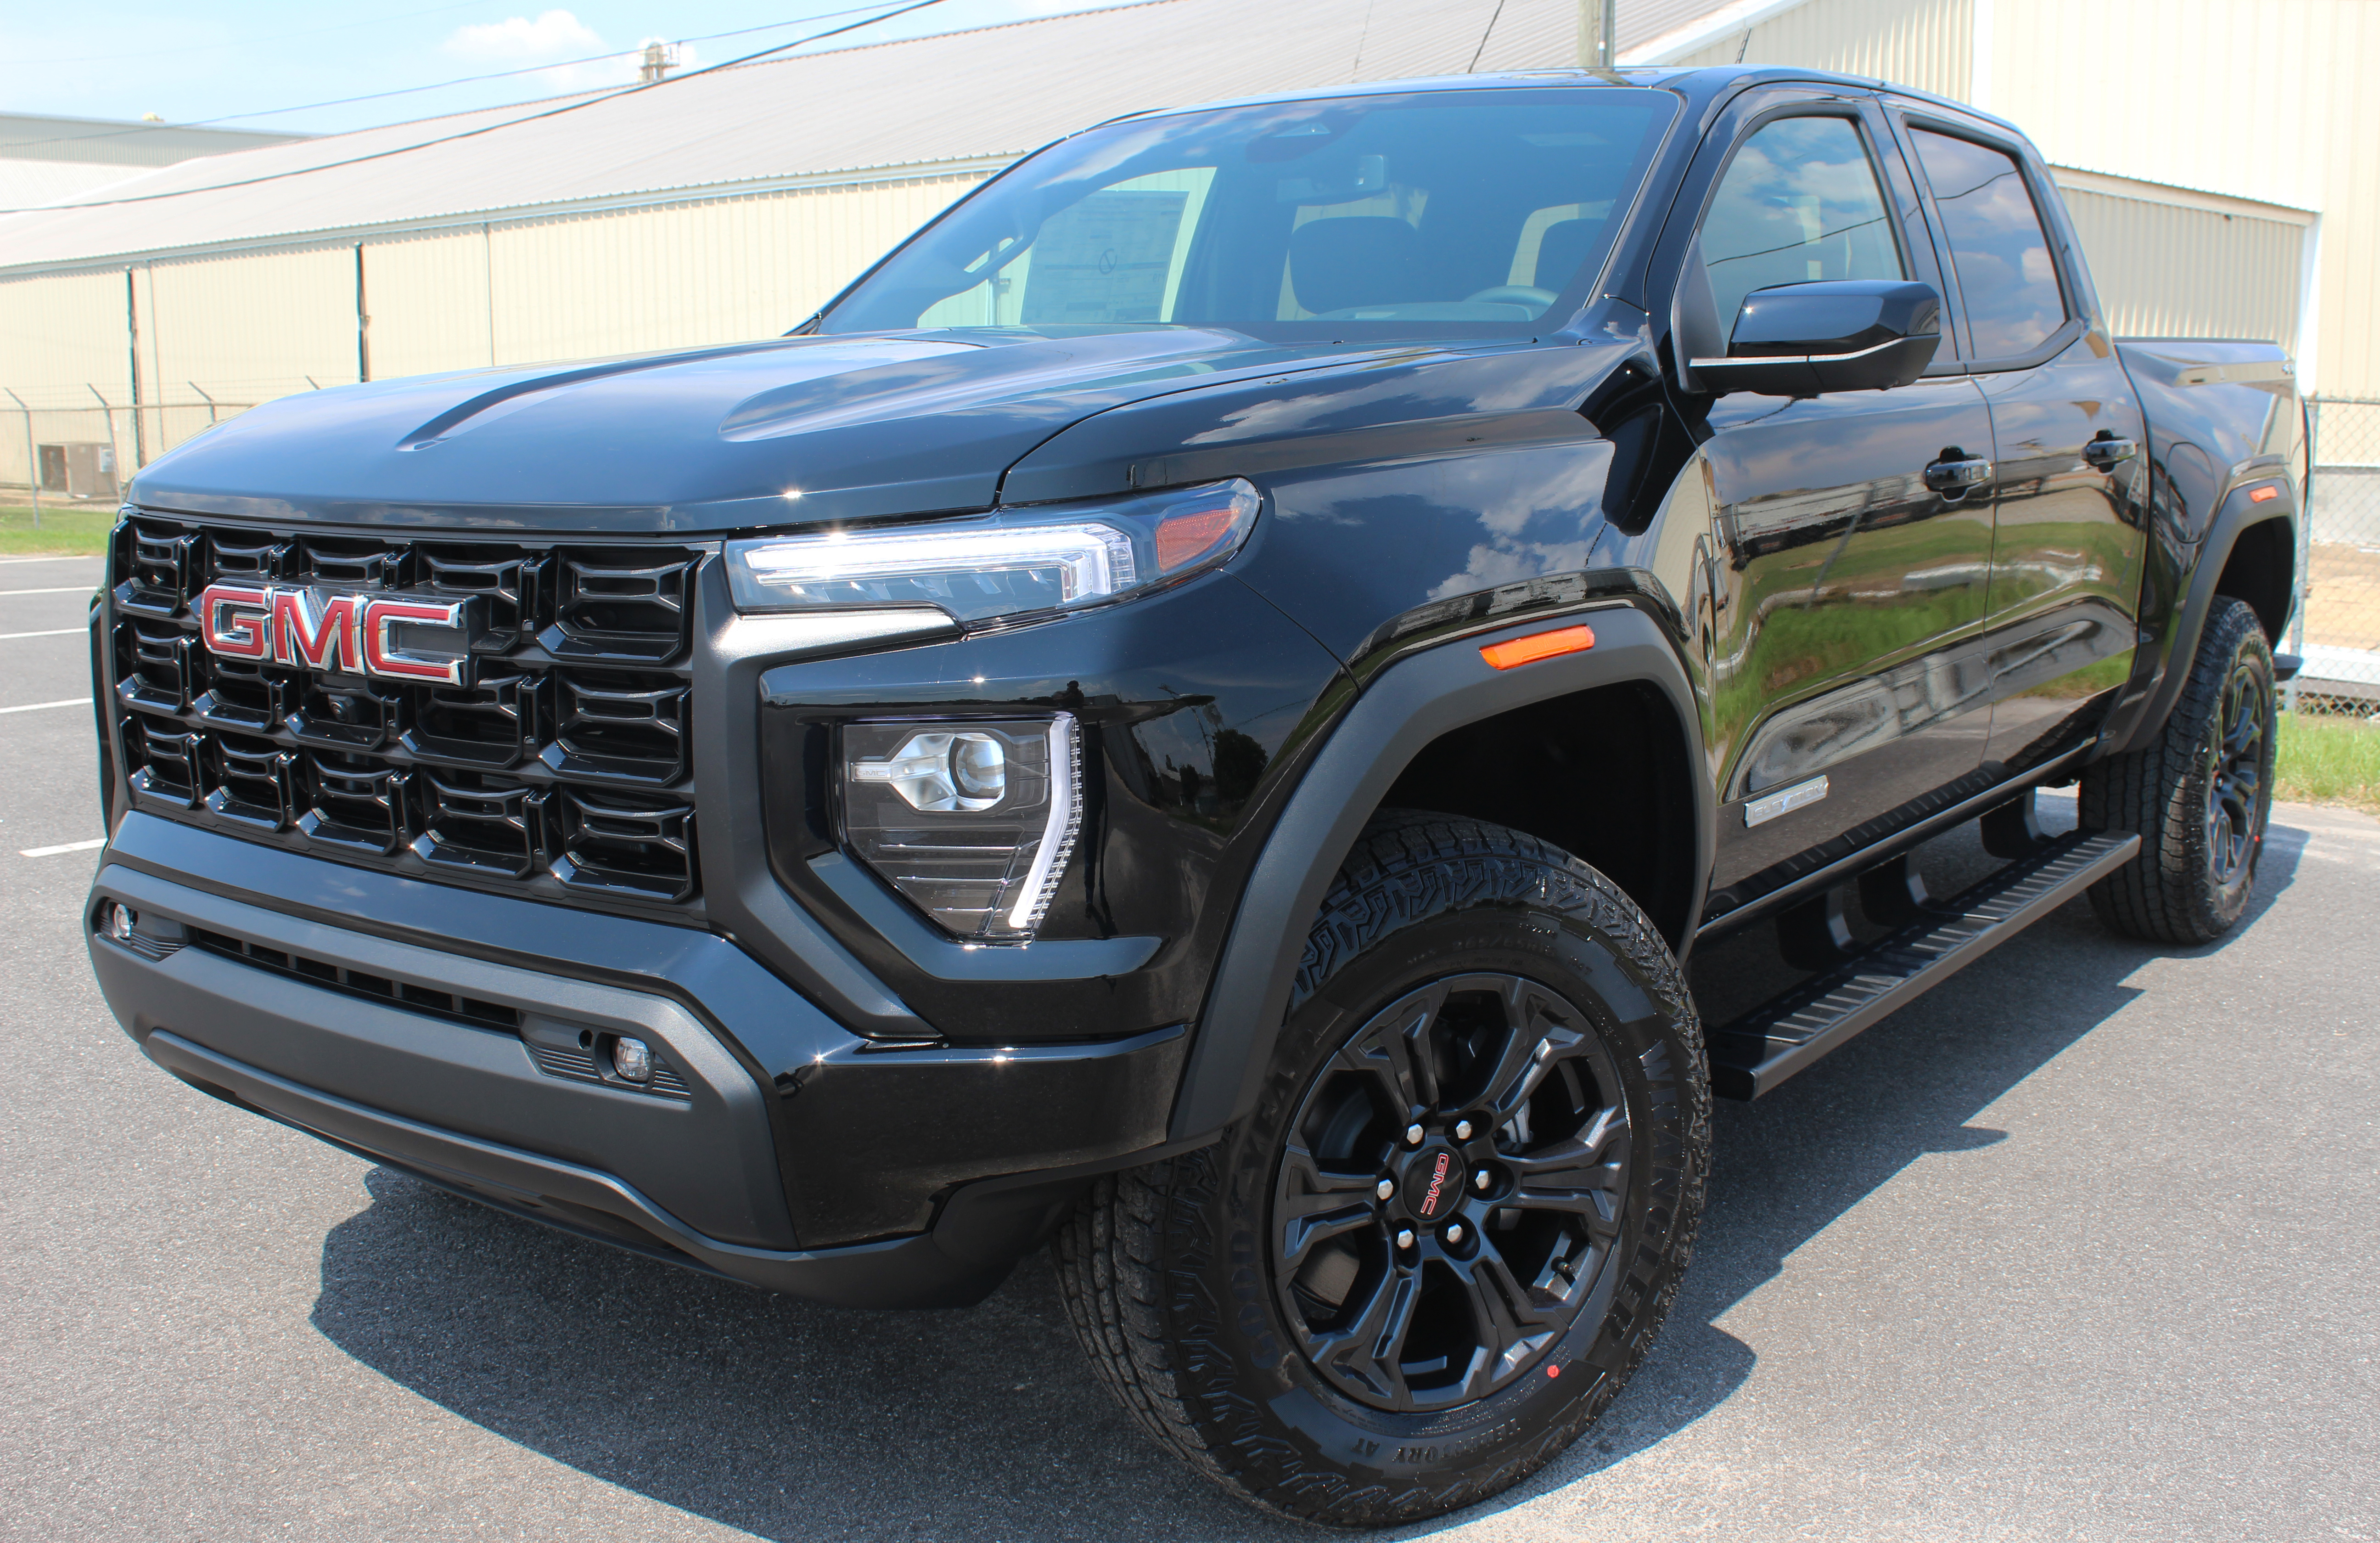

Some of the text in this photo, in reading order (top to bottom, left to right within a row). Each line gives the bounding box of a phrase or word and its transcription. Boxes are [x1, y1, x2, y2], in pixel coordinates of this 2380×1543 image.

[202, 583, 464, 686] GMC
[1754, 784, 1824, 818] ELEVATION
[1420, 1153, 1449, 1216] GMC
[1600, 1039, 1680, 1341] WRANGLER
[1350, 1438, 1381, 1459] AT
[1392, 1417, 1521, 1465] TERRITORY
